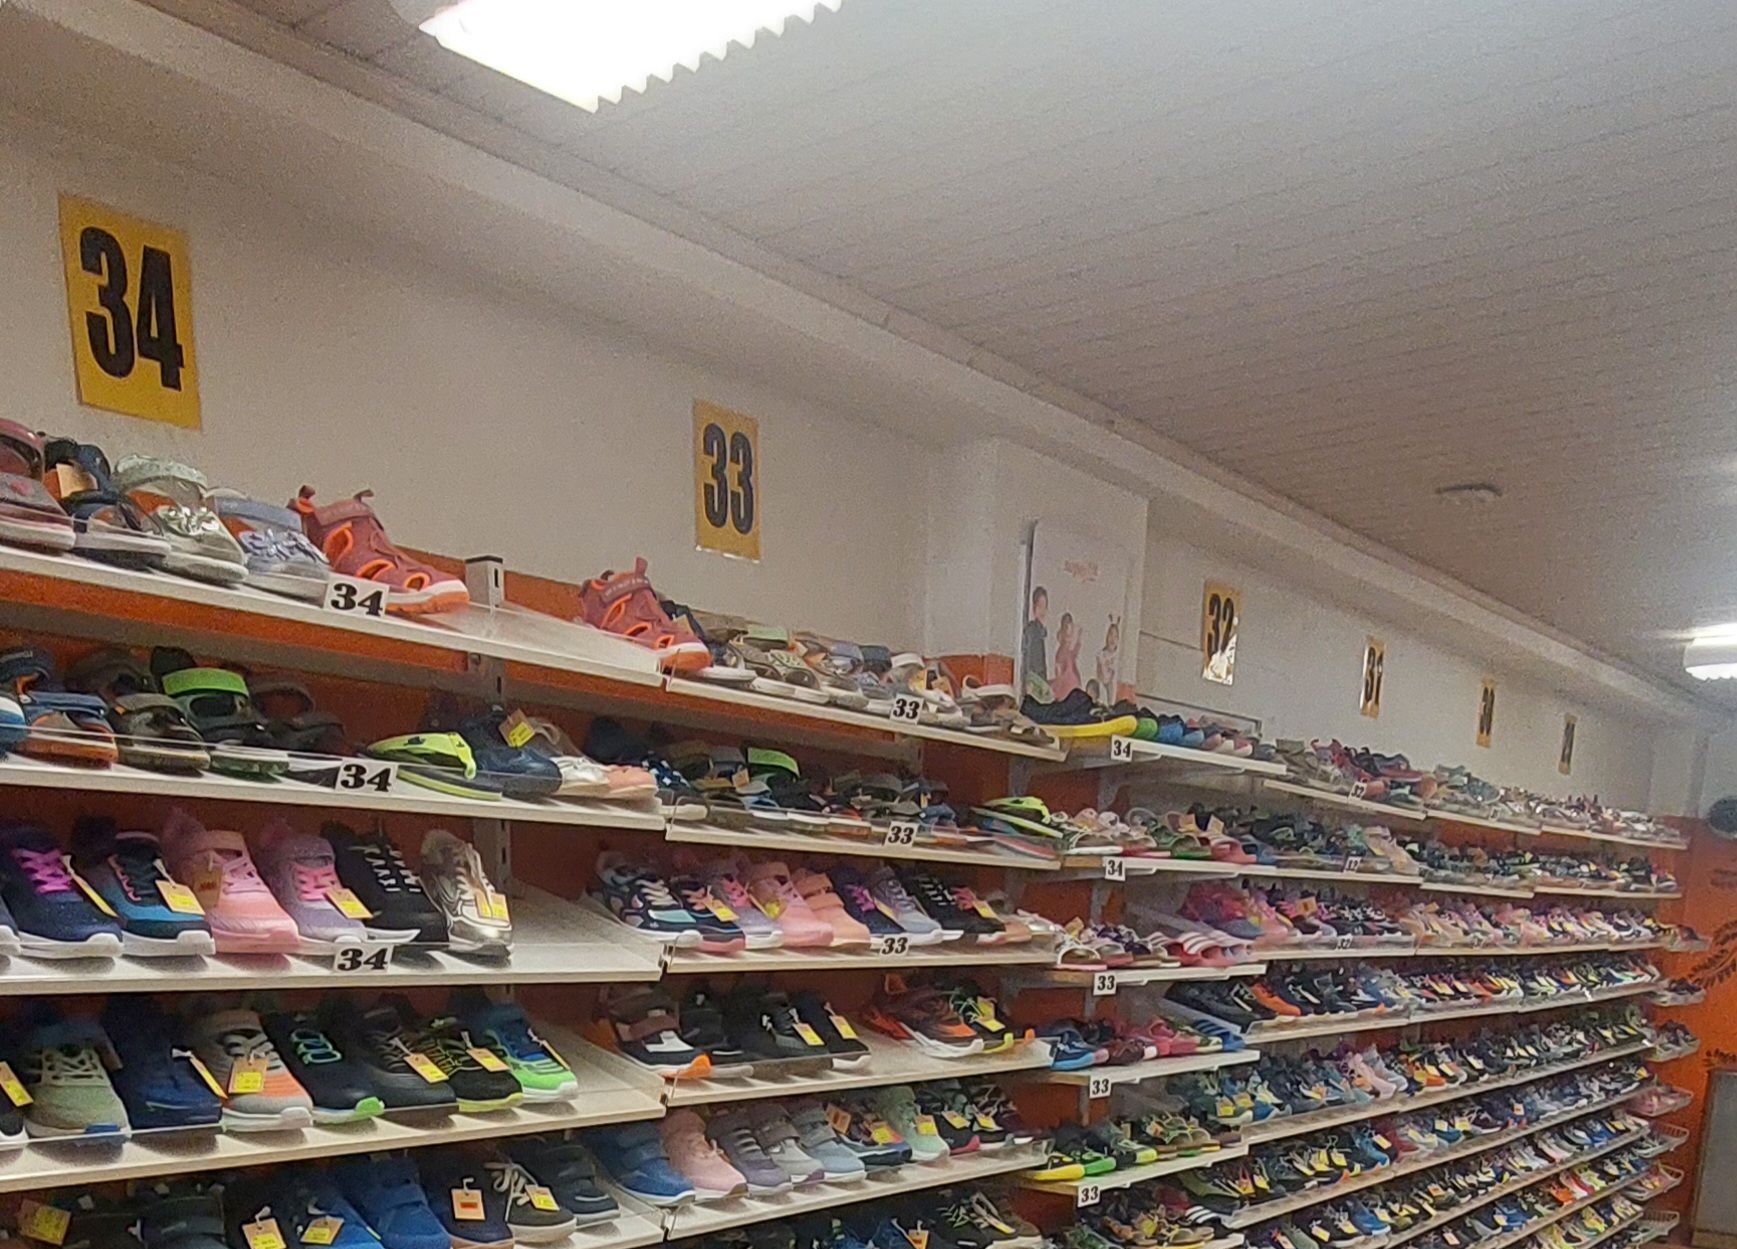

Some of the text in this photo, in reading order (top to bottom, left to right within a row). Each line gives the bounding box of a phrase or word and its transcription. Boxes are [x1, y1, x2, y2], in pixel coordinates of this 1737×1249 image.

[80, 227, 184, 392] 34
[703, 422, 755, 535] 33
[331, 582, 383, 617] 34
[1207, 593, 1235, 664] 32
[892, 698, 920, 719] 33
[1113, 740, 1131, 758] 34
[340, 763, 392, 793] 34
[887, 824, 914, 845] 33
[1108, 859, 1124, 877] 34
[881, 936, 909, 955] 33
[337, 946, 388, 971] 34
[1097, 975, 1115, 991] 33
[1092, 1078, 1109, 1095] 33
[1081, 1185, 1099, 1203] 33
